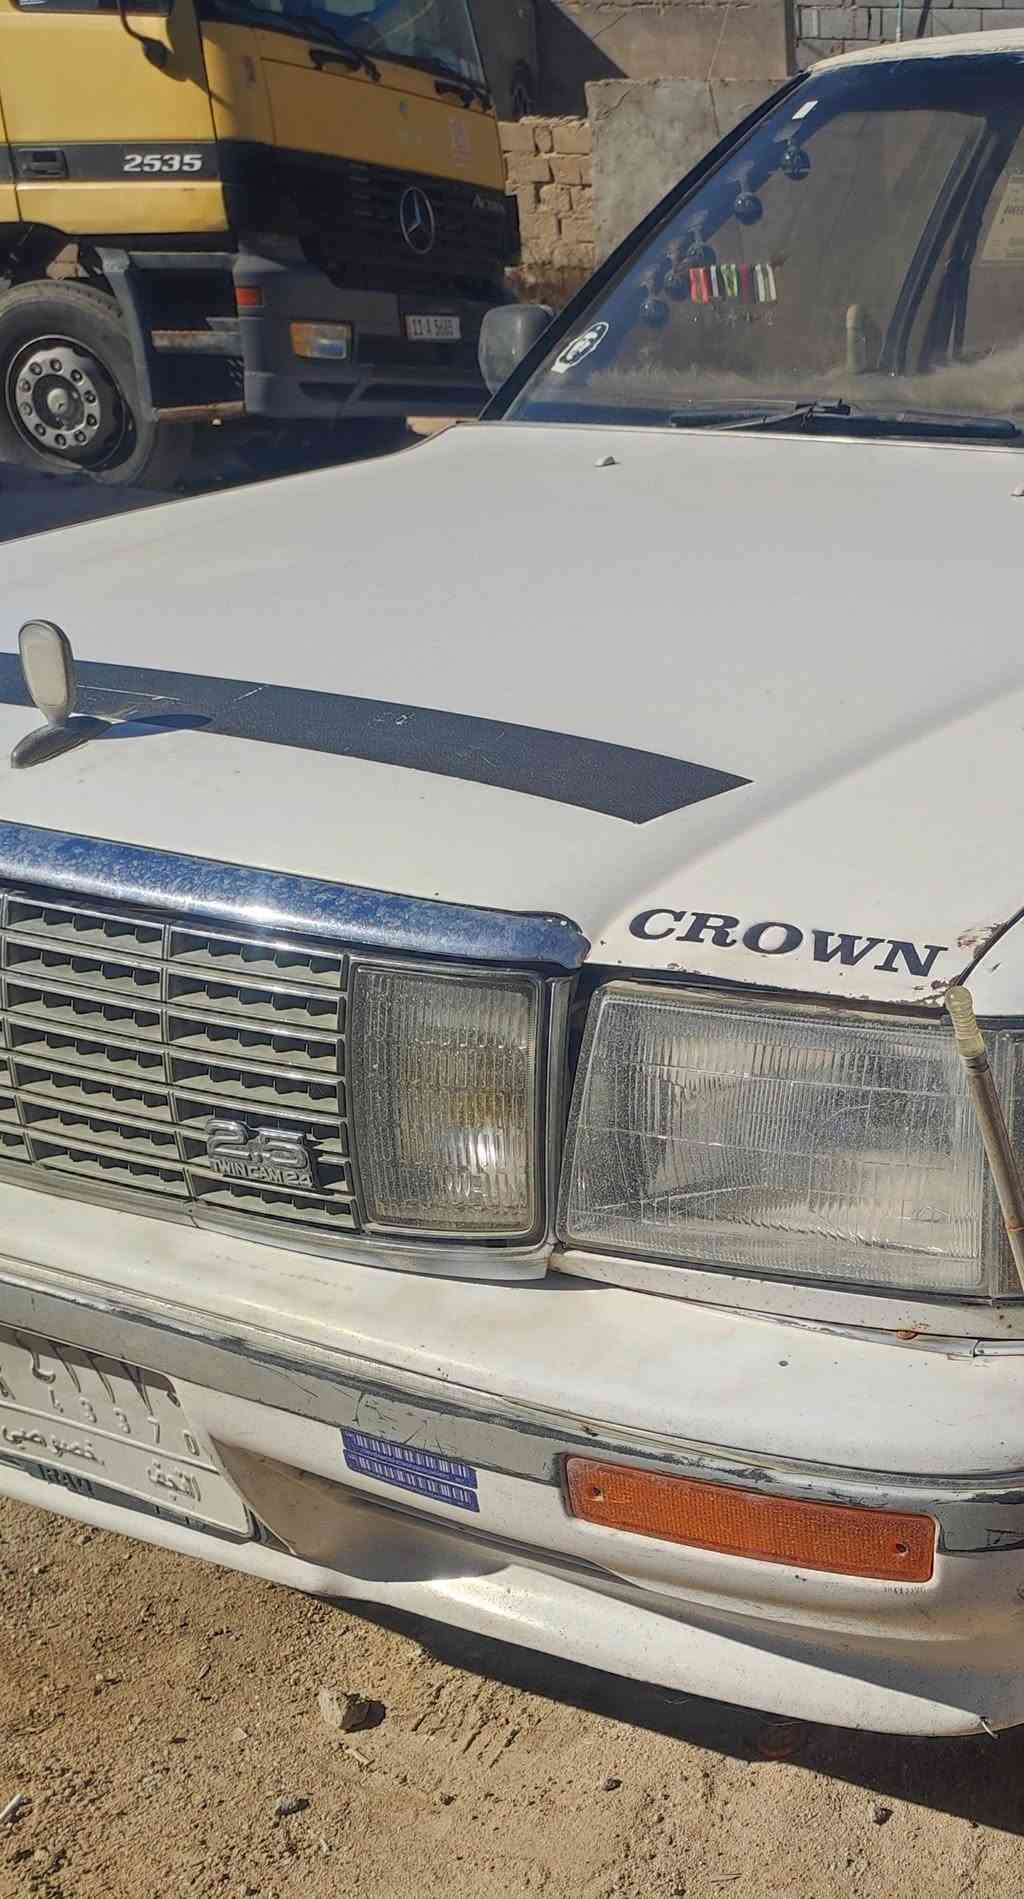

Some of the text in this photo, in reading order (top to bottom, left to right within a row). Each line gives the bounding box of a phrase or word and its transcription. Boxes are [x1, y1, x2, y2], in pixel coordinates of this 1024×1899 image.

[123, 153, 204, 173] 2535
[628, 908, 949, 977] CROWN
[210, 1159, 250, 1177] TWIN
